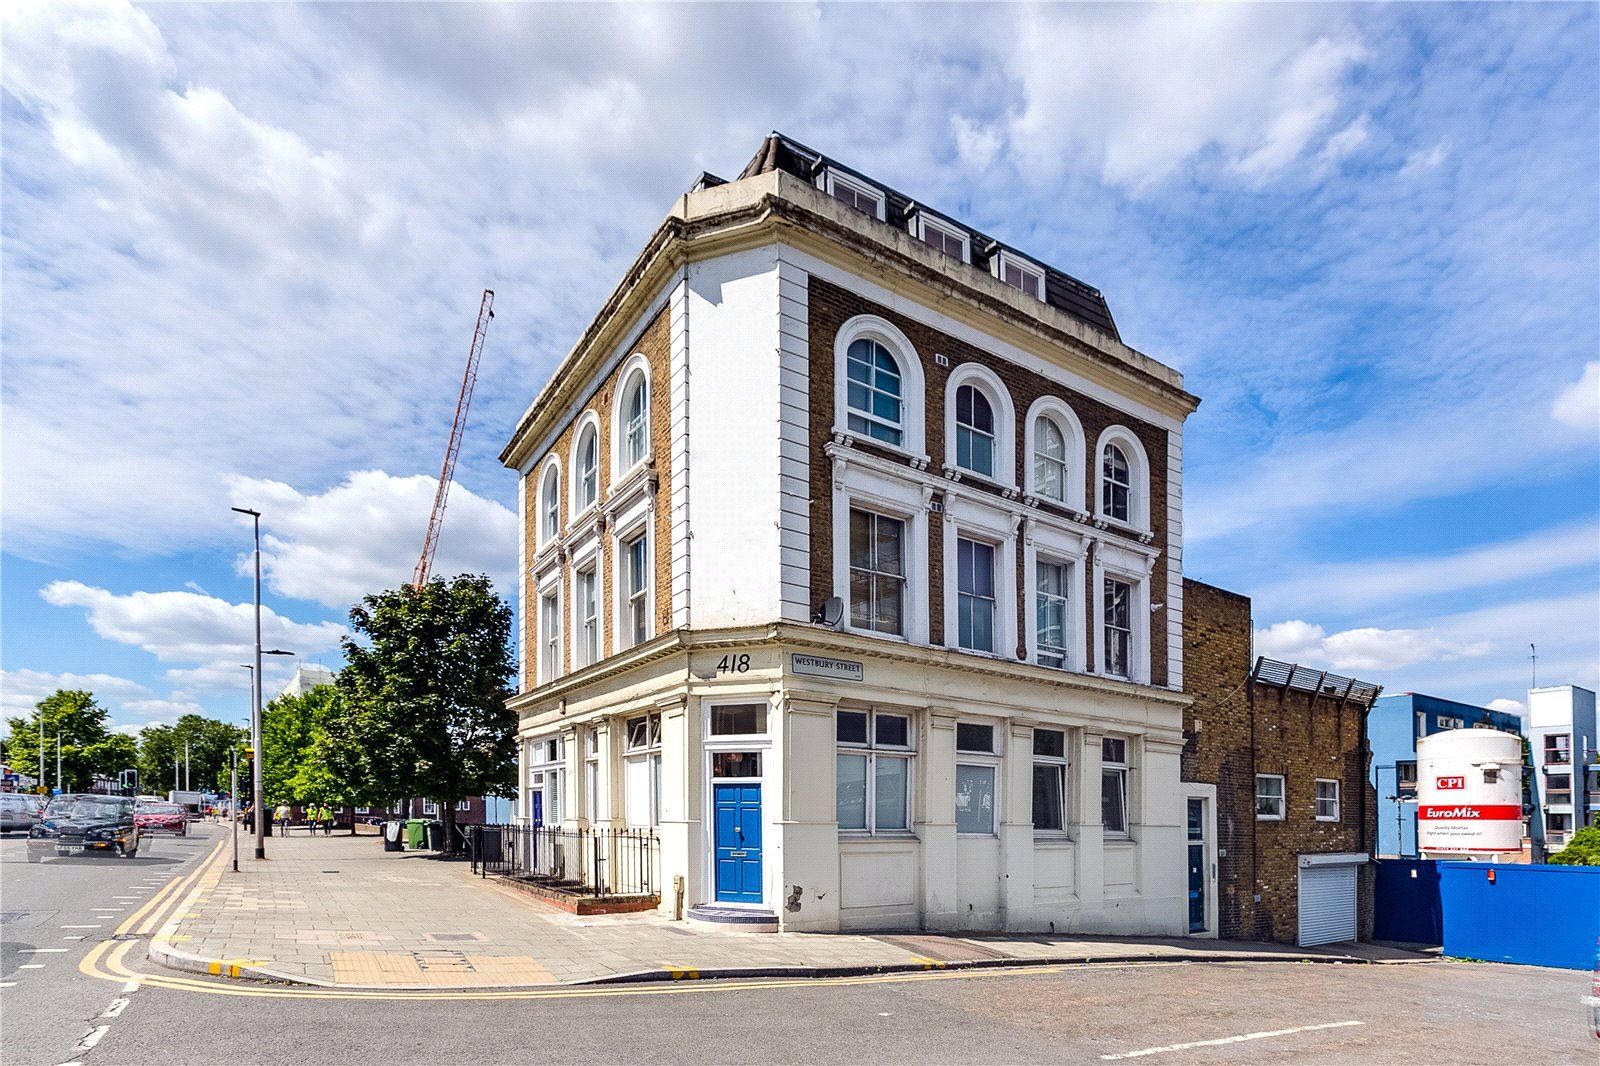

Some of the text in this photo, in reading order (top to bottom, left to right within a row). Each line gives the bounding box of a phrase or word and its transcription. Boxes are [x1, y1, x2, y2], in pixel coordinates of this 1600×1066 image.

[716, 654, 751, 674] 418
[795, 657, 861, 673] WESTBURY STREET
[1437, 778, 1463, 788] CPI
[1427, 807, 1480, 818] EuroMix
